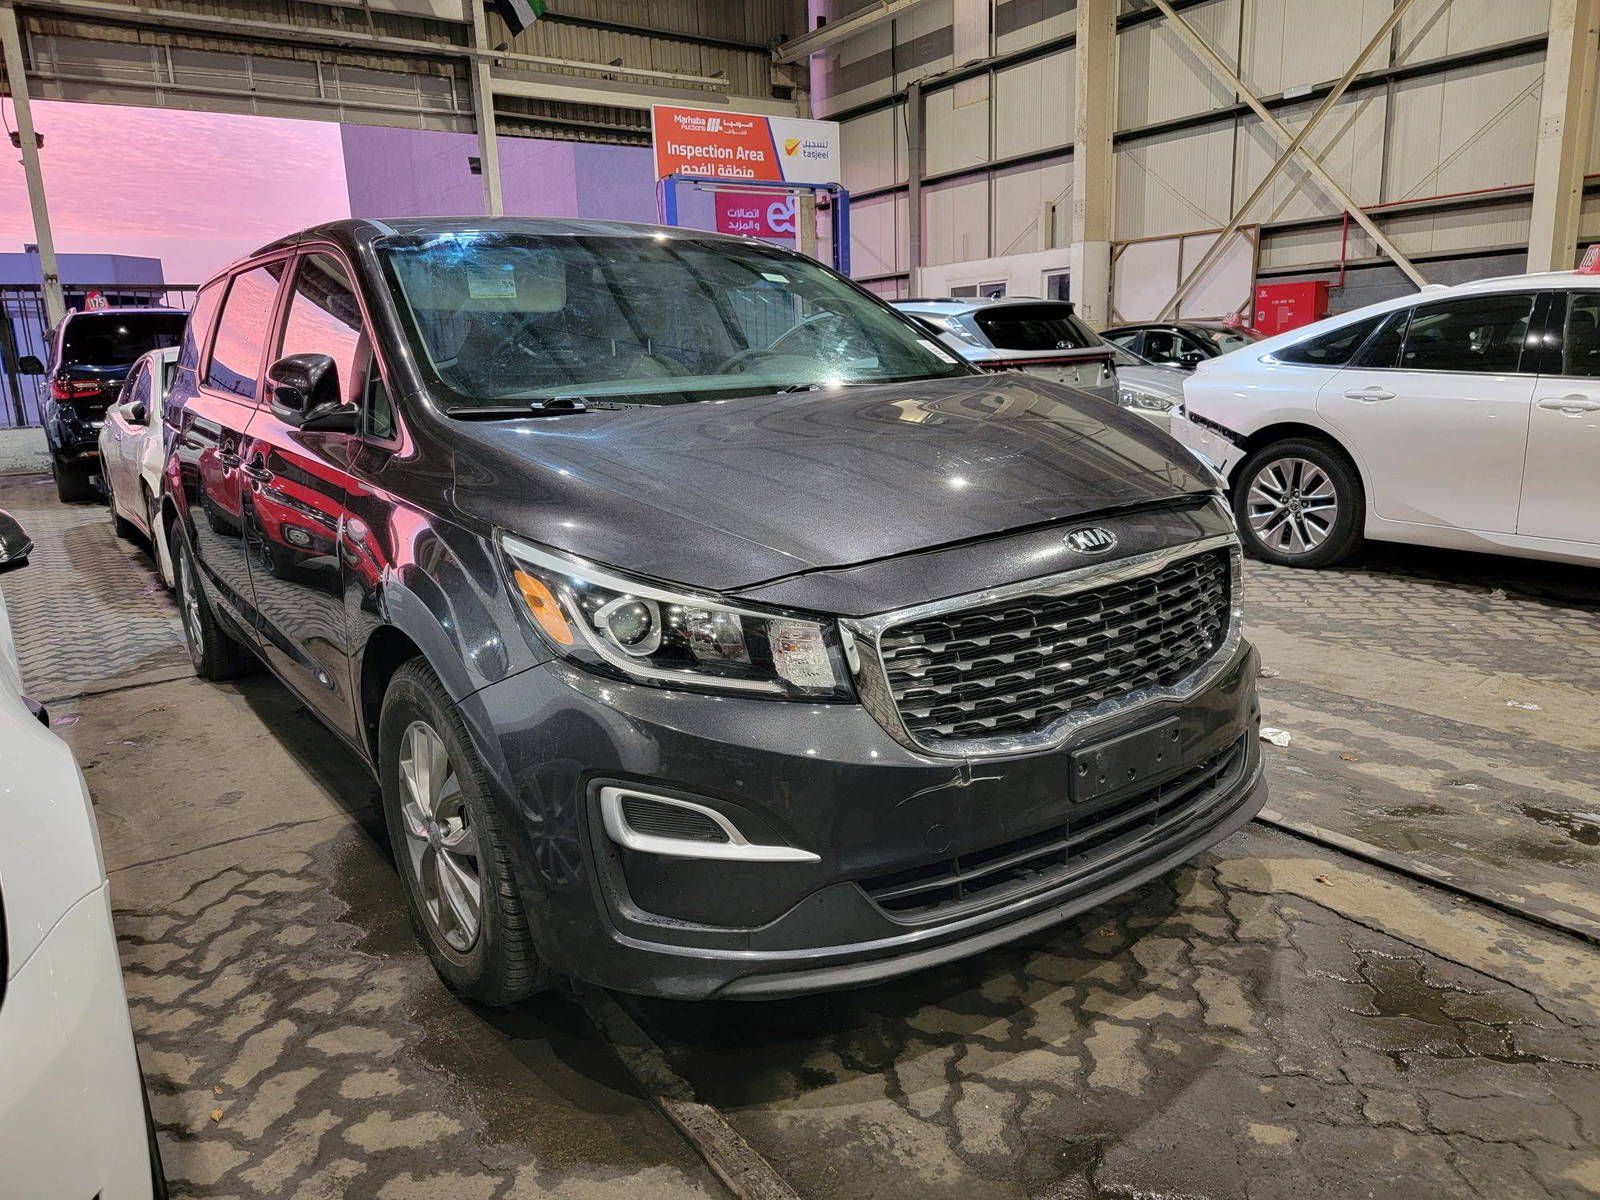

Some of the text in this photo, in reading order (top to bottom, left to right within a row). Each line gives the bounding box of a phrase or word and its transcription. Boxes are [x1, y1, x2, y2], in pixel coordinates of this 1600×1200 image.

[674, 114, 706, 125] Marhaba
[667, 141, 765, 161] Inspection Area
[802, 150, 829, 160] tasjeel
[1070, 529, 1112, 550] KIA
